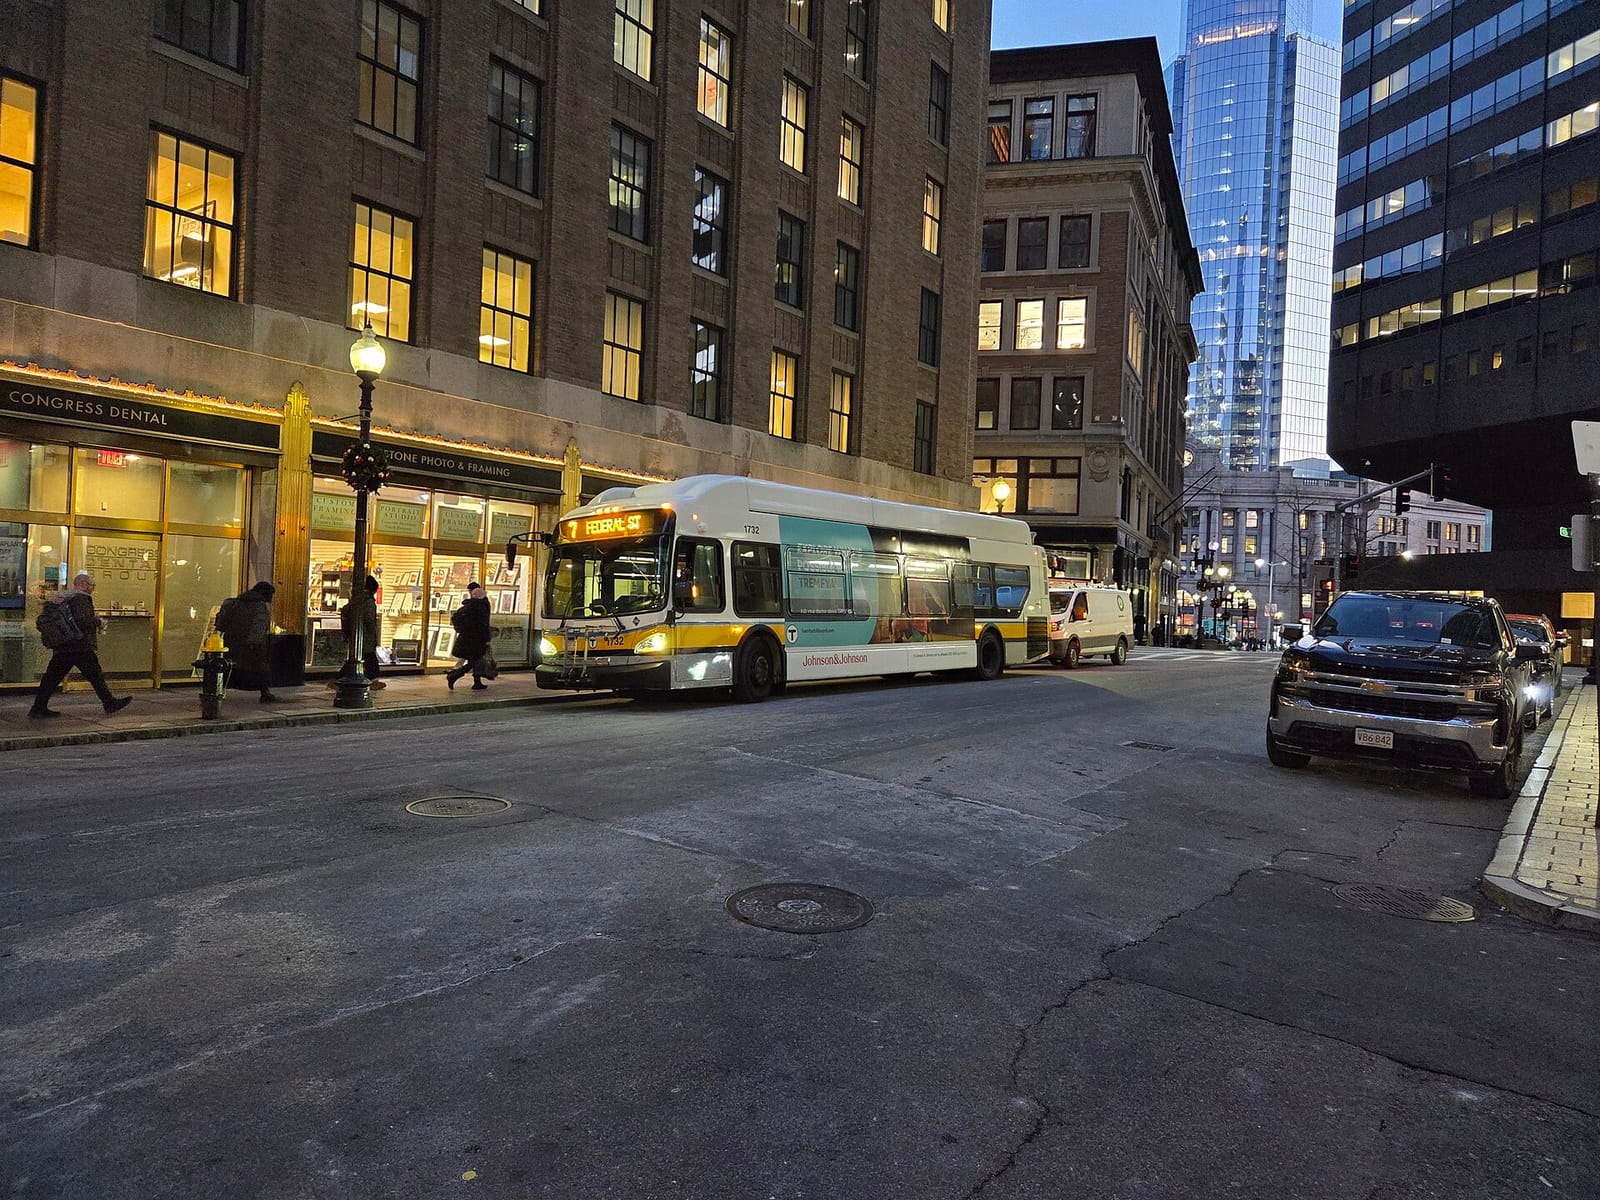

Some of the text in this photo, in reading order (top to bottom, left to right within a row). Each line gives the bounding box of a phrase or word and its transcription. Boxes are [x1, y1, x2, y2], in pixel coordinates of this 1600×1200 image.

[8, 390, 168, 426] CONGRESS DENTAL
[421, 455, 455, 469] PHOTO
[457, 462, 465, 471] &
[467, 462, 511, 477] FRAMING
[568, 515, 641, 539] 7 FEDERAL ST
[744, 525, 760, 535] 1732
[803, 653, 868, 667] Johnson&Johnson
